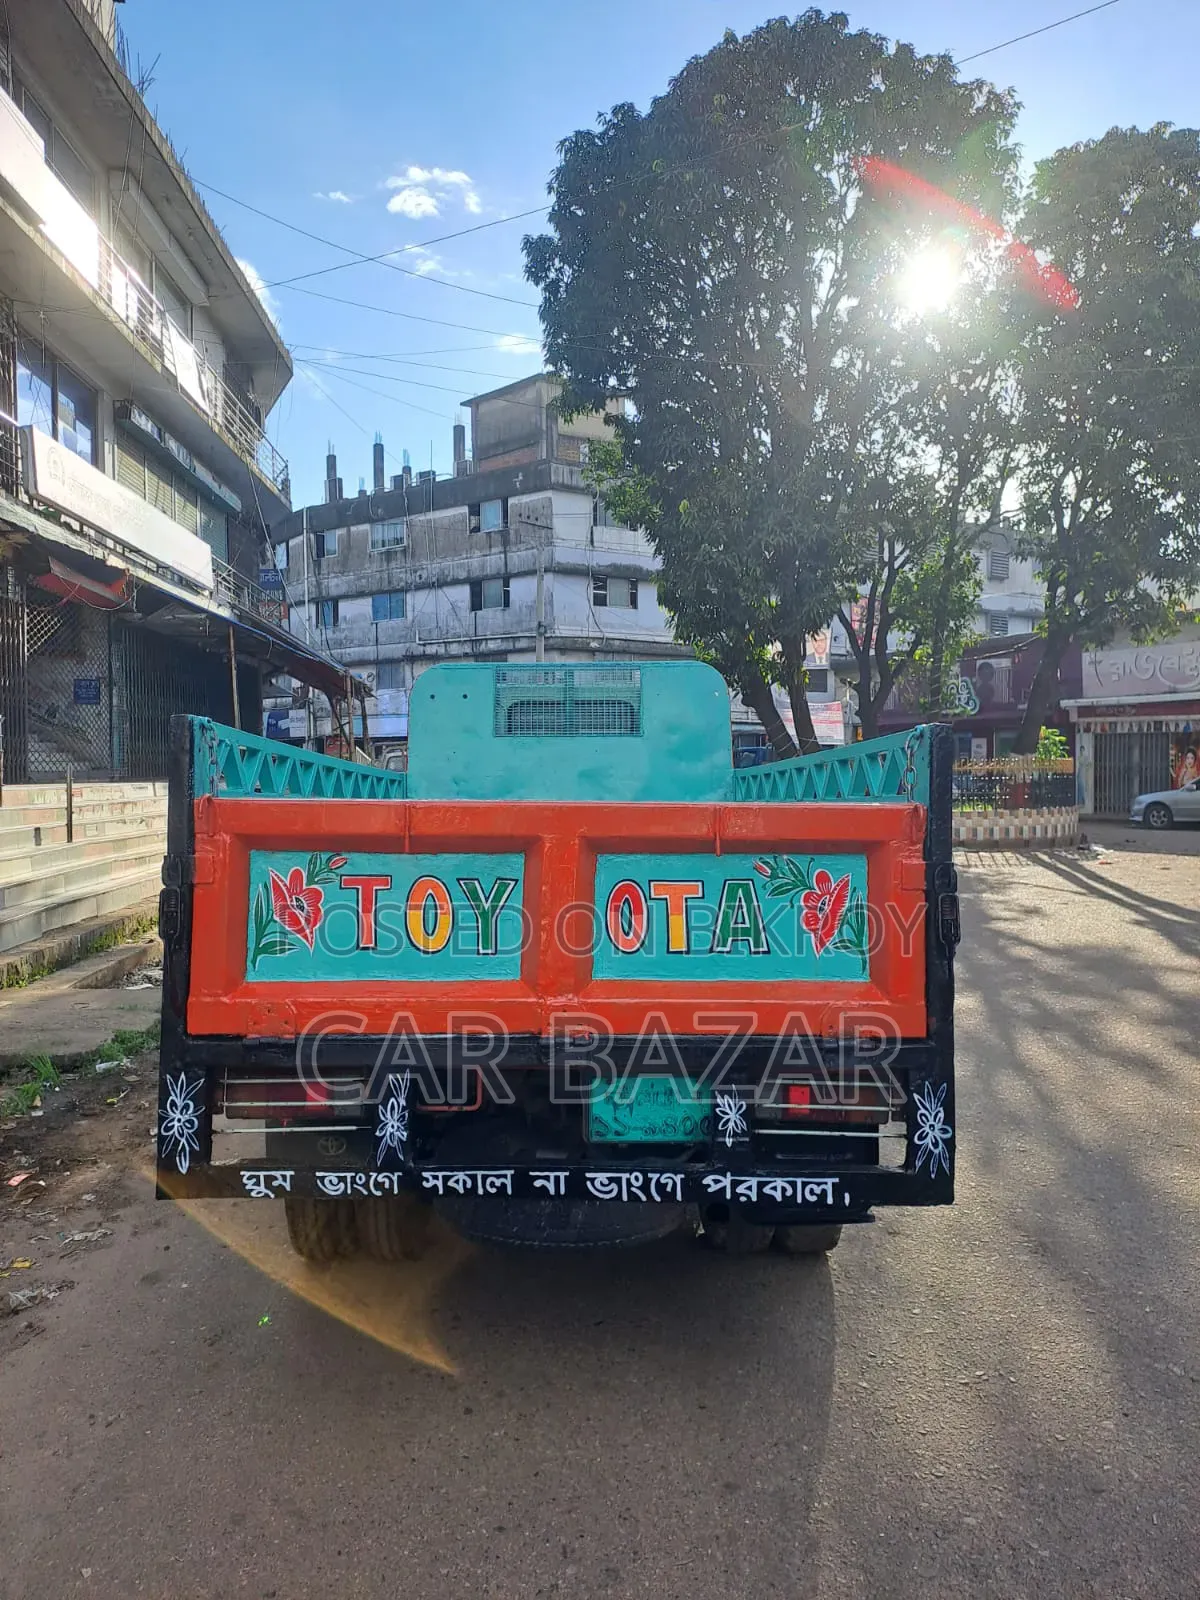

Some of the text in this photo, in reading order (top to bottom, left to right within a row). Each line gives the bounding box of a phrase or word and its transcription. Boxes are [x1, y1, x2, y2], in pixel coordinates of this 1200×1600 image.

[339, 874, 769, 955] TOY OTA
[240, 1170, 295, 1199] ঘুম
[315, 1170, 403, 1197] ভাংগে
[422, 1169, 514, 1196] সকাল
[530, 1170, 569, 1195] না
[585, 1170, 685, 1202] ভাংগে
